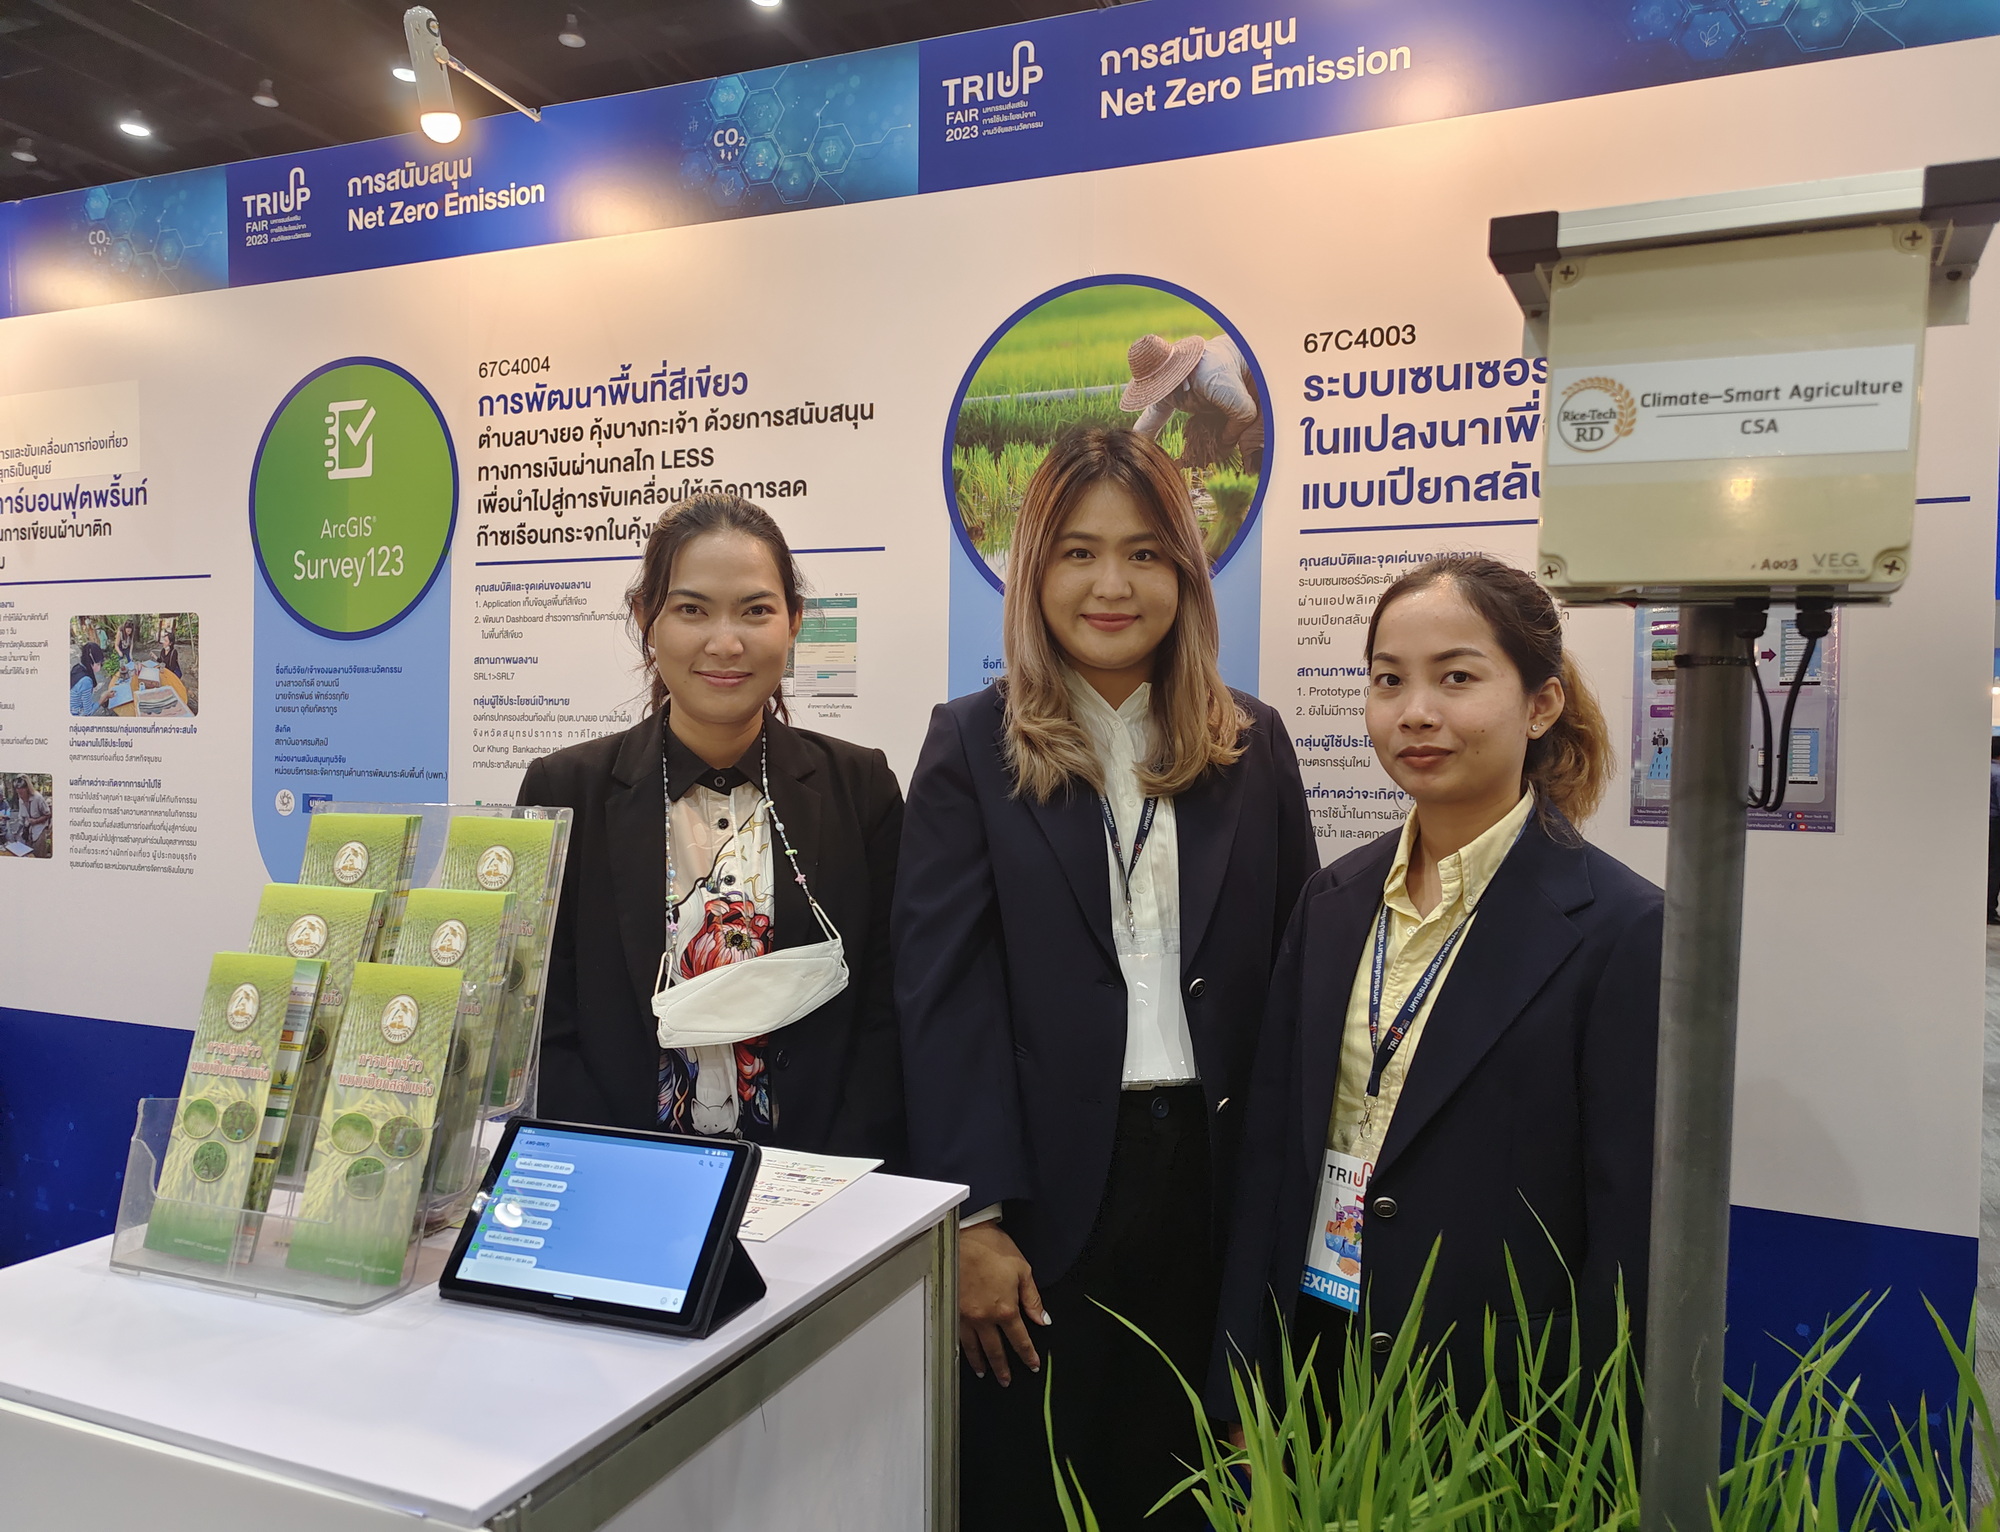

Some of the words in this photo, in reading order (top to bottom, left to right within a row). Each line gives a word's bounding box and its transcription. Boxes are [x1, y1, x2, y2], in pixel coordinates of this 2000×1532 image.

[1100, 17, 1297, 76] การสนับสนุน
[942, 40, 1044, 107] TRIUP
[1101, 85, 1156, 119] Net
[1164, 76, 1241, 109] Zero
[1251, 45, 1411, 95] Emission
[946, 107, 979, 126] FAIR
[945, 125, 979, 142] 2023
[347, 157, 472, 197] การสนับสนุน
[242, 167, 311, 218] TRIUP
[348, 206, 385, 231] Net
[389, 201, 438, 226] Zero
[444, 182, 545, 217] Emission
[245, 219, 269, 233] FAIR
[245, 234, 269, 247] 2023
[1304, 324, 1416, 354] 67C4003
[478, 355, 551, 379] 67C4004
[478, 360, 749, 417] การพัฒนาพื้นที่สีเขียว
[1789, 378, 1903, 401] Agriculture
[1300, 390, 1547, 456] ในแปลงนาเพื่
[1562, 407, 1617, 422] Rice-Tech
[478, 424, 584, 450] ตำบลบางยอ
[589, 411, 699, 448] คุ้งบางกะเจ้า
[704, 400, 874, 433] ด้วยการสนับสนุน
[1740, 418, 1779, 435] CSA
[1575, 426, 1604, 443] RD
[477, 450, 655, 482] ทางการเงินผ่านกลไก
[661, 447, 715, 470] LESS
[476, 516, 656, 548] ก๊าซเรือนกระจกในคุ้ง
[293, 545, 404, 587] Survey123
[475, 580, 592, 595] คุณสมบัติและจุดเด่นของผลงาน
[483, 599, 521, 610] Application
[506, 614, 544, 623] Dashboard
[1297, 631, 1331, 645] มากขึ้น
[473, 655, 539, 665] สถานภาพผลงาน
[473, 672, 515, 681] SRL1>SRL7
[1297, 687, 1306, 696] 1.
[1309, 687, 1361, 698] Prototype
[473, 695, 570, 709] กลุ่มผู้ใช้ประโยชน์เป้าหมาย
[1296, 706, 1306, 716] 2.
[473, 745, 486, 753] Our
[487, 745, 509, 754] Khung
[513, 745, 551, 754] Bankachao
